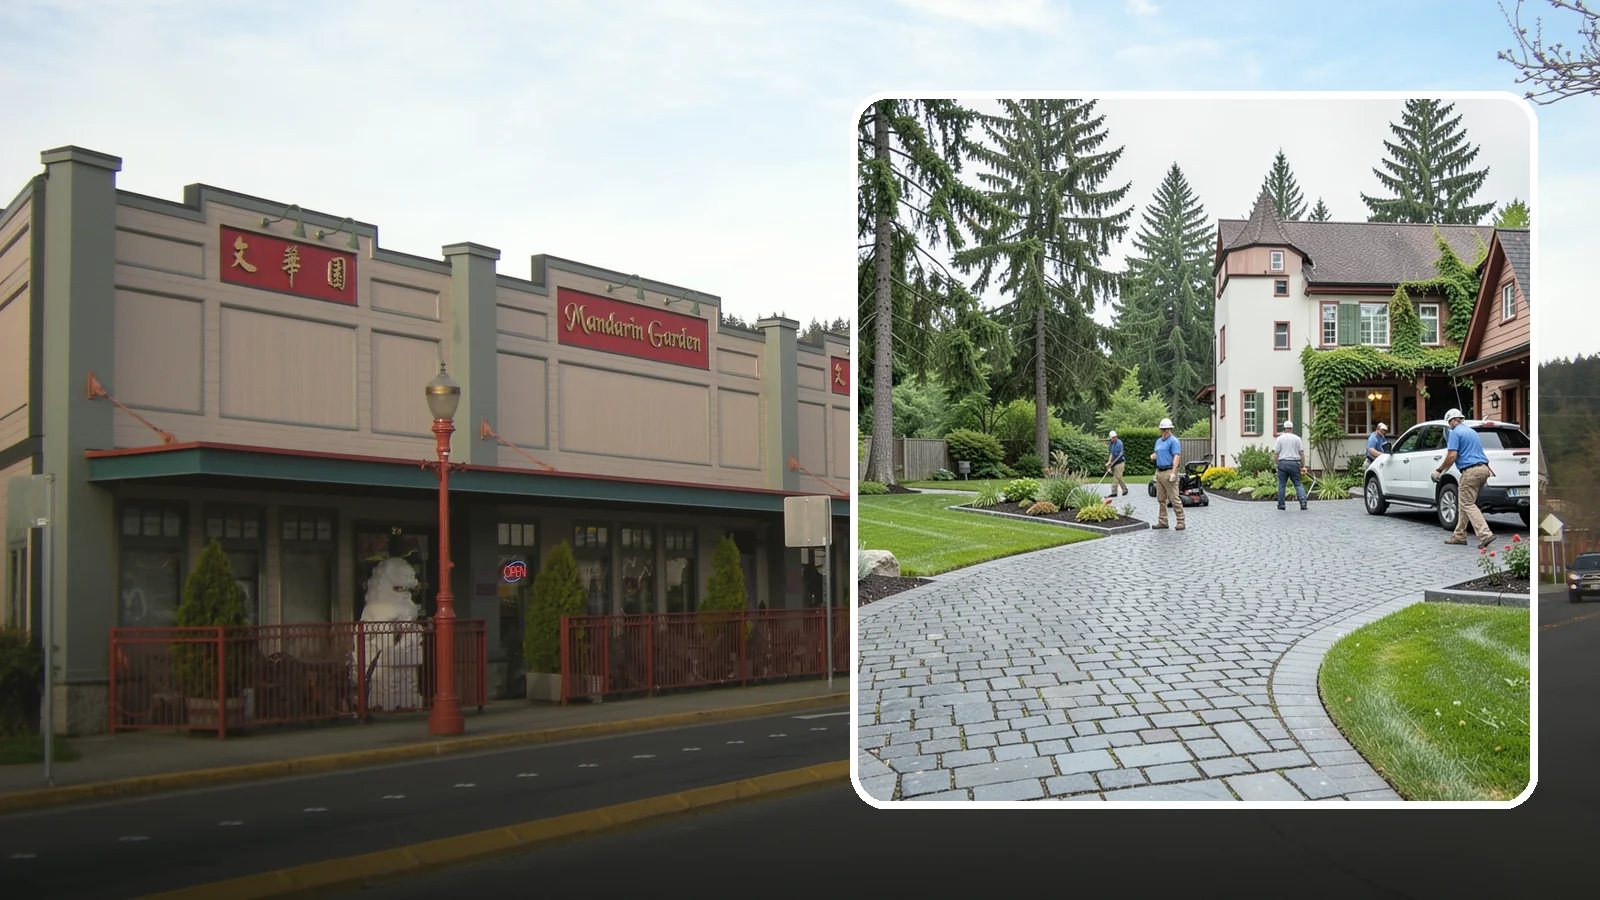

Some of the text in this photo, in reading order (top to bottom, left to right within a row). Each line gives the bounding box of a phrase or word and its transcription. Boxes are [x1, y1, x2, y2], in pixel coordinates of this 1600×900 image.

[231, 235, 347, 291] 文華園
[564, 302, 701, 352] Mandarin Garden
[503, 565, 527, 579] OPEN
